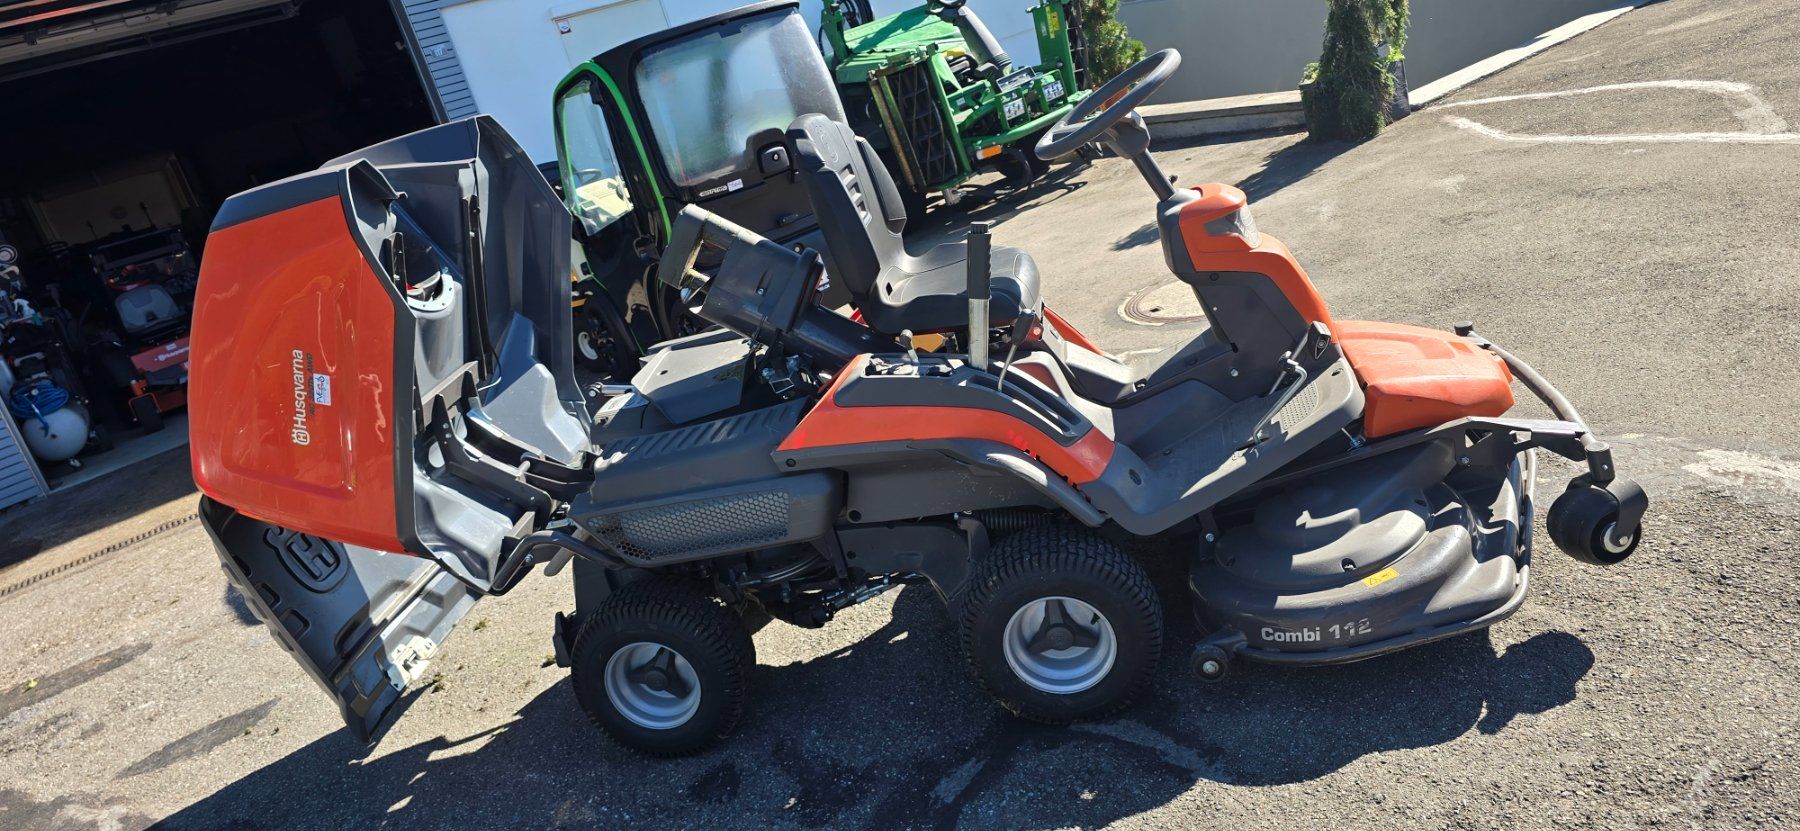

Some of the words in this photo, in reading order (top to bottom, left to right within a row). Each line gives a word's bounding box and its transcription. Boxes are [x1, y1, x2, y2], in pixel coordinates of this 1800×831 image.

[292, 349, 307, 429] Husqvarna
[1261, 627, 1320, 642] Combi
[1328, 618, 1372, 639] 112
